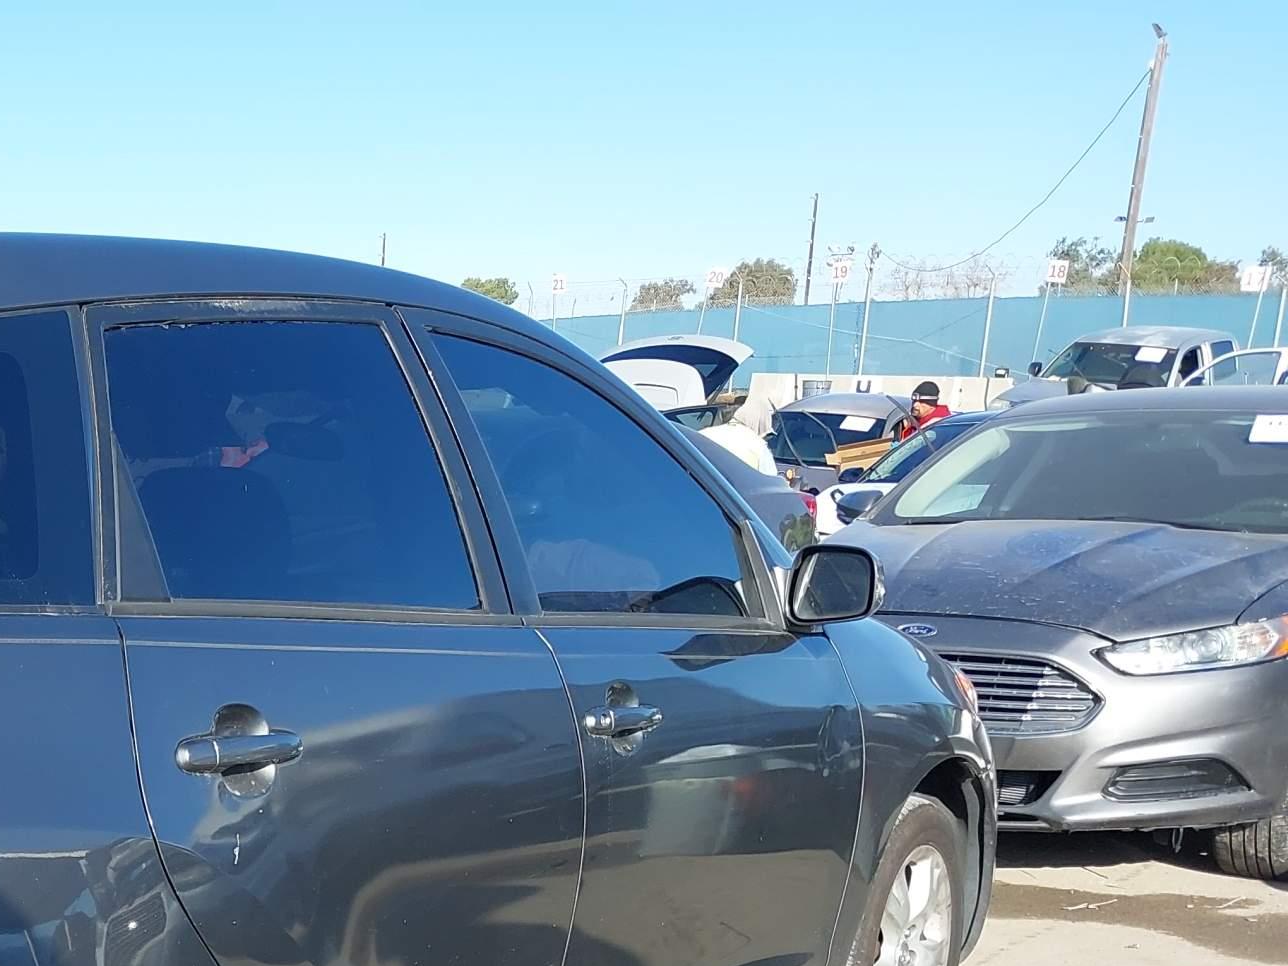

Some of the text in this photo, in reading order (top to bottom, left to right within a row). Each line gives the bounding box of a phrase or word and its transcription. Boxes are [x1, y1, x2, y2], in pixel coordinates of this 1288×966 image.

[708, 271, 724, 283] 20
[832, 265, 848, 279] 19
[1048, 264, 1066, 278] 18
[552, 279, 565, 290] 21
